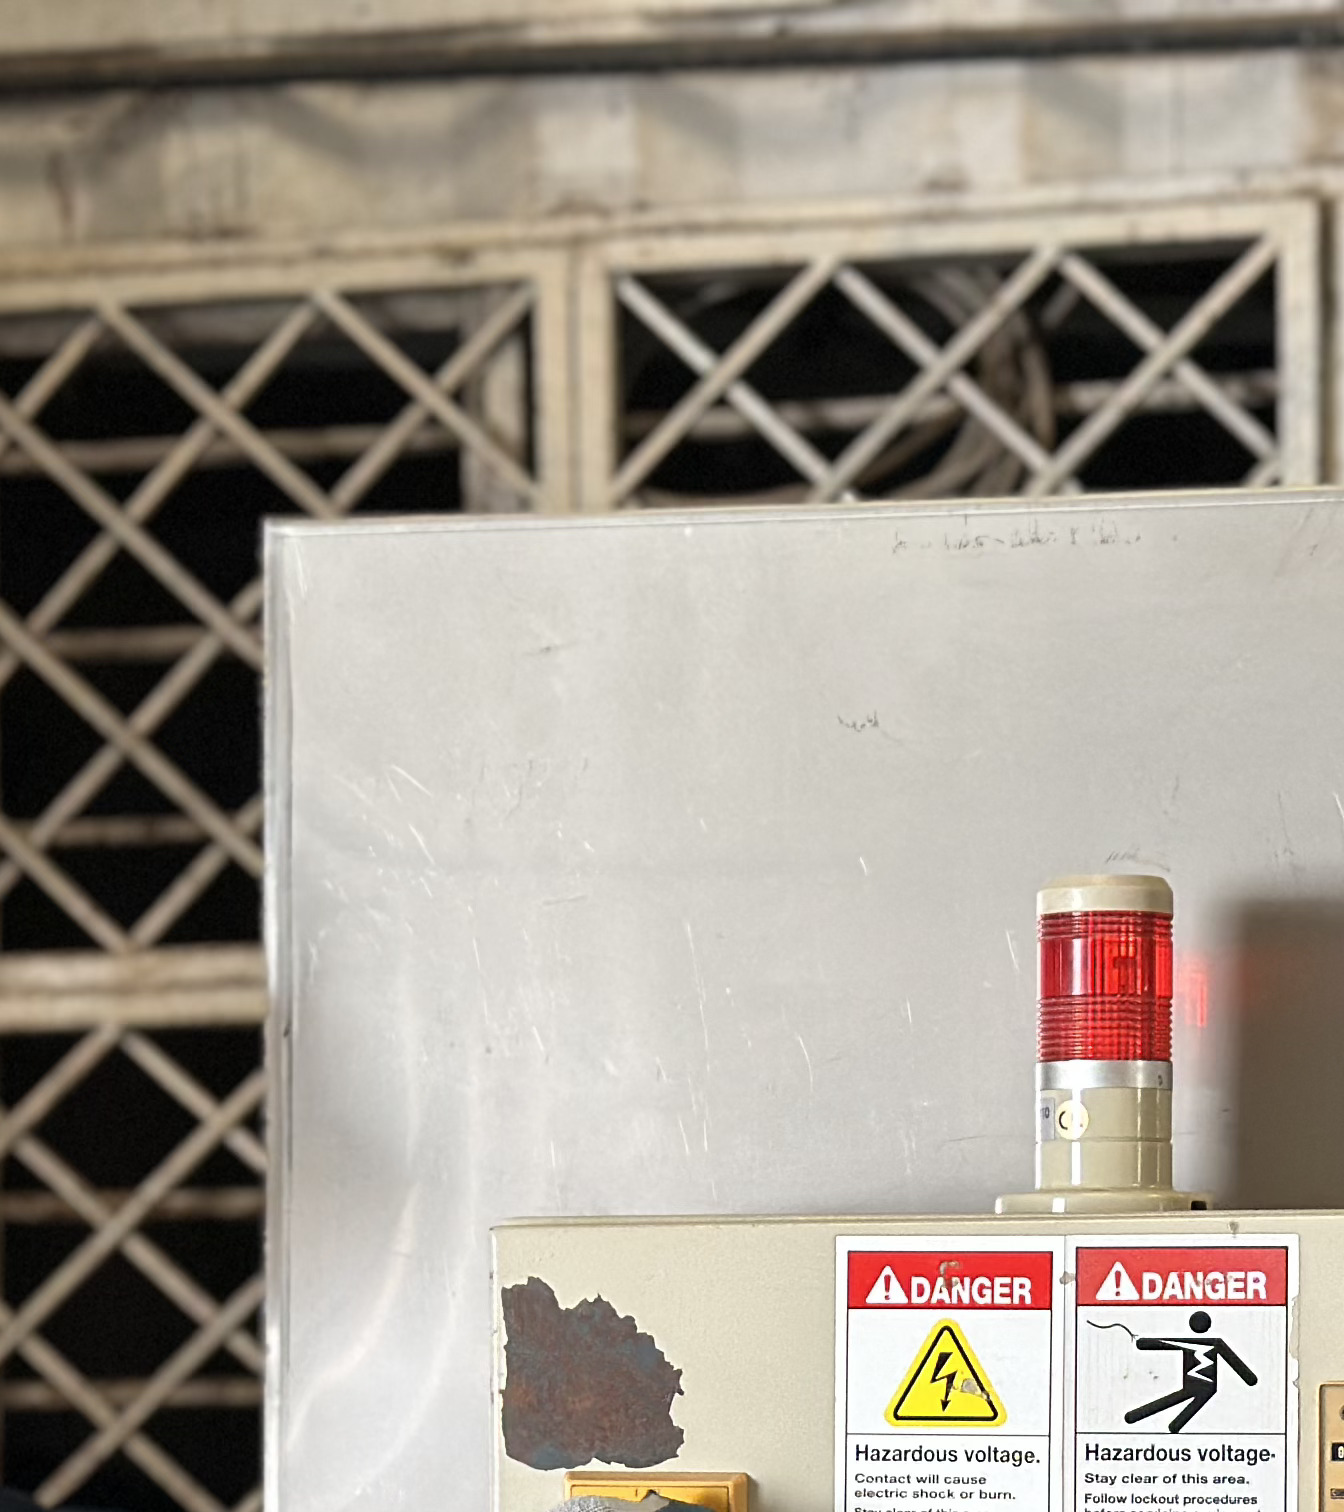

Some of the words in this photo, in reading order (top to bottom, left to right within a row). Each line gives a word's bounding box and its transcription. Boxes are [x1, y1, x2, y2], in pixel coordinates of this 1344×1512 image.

[910, 1275, 1033, 1306] DANGER
[1141, 1270, 1268, 1301] DANGER
[855, 1443, 958, 1463] Hazardous
[964, 1445, 1041, 1467] voltage.
[1085, 1443, 1192, 1462] Hazardous
[854, 1473, 912, 1485] Contact
[915, 1474, 940, 1485] will
[943, 1475, 987, 1486] cause
[1084, 1472, 1118, 1486] Stay
[1121, 1473, 1159, 1485] clear
[1162, 1473, 1178, 1485] of
[1181, 1473, 1208, 1485] this
[1212, 1475, 1251, 1486] area.
[854, 1488, 908, 1499] electric
[912, 1488, 955, 1500] shock
[959, 1490, 974, 1500] or
[979, 1489, 1017, 1501] burn.
[1084, 1493, 1127, 1505] Follow
[1130, 1493, 1180, 1505] lockout
[1183, 1494, 1258, 1507] procedures
